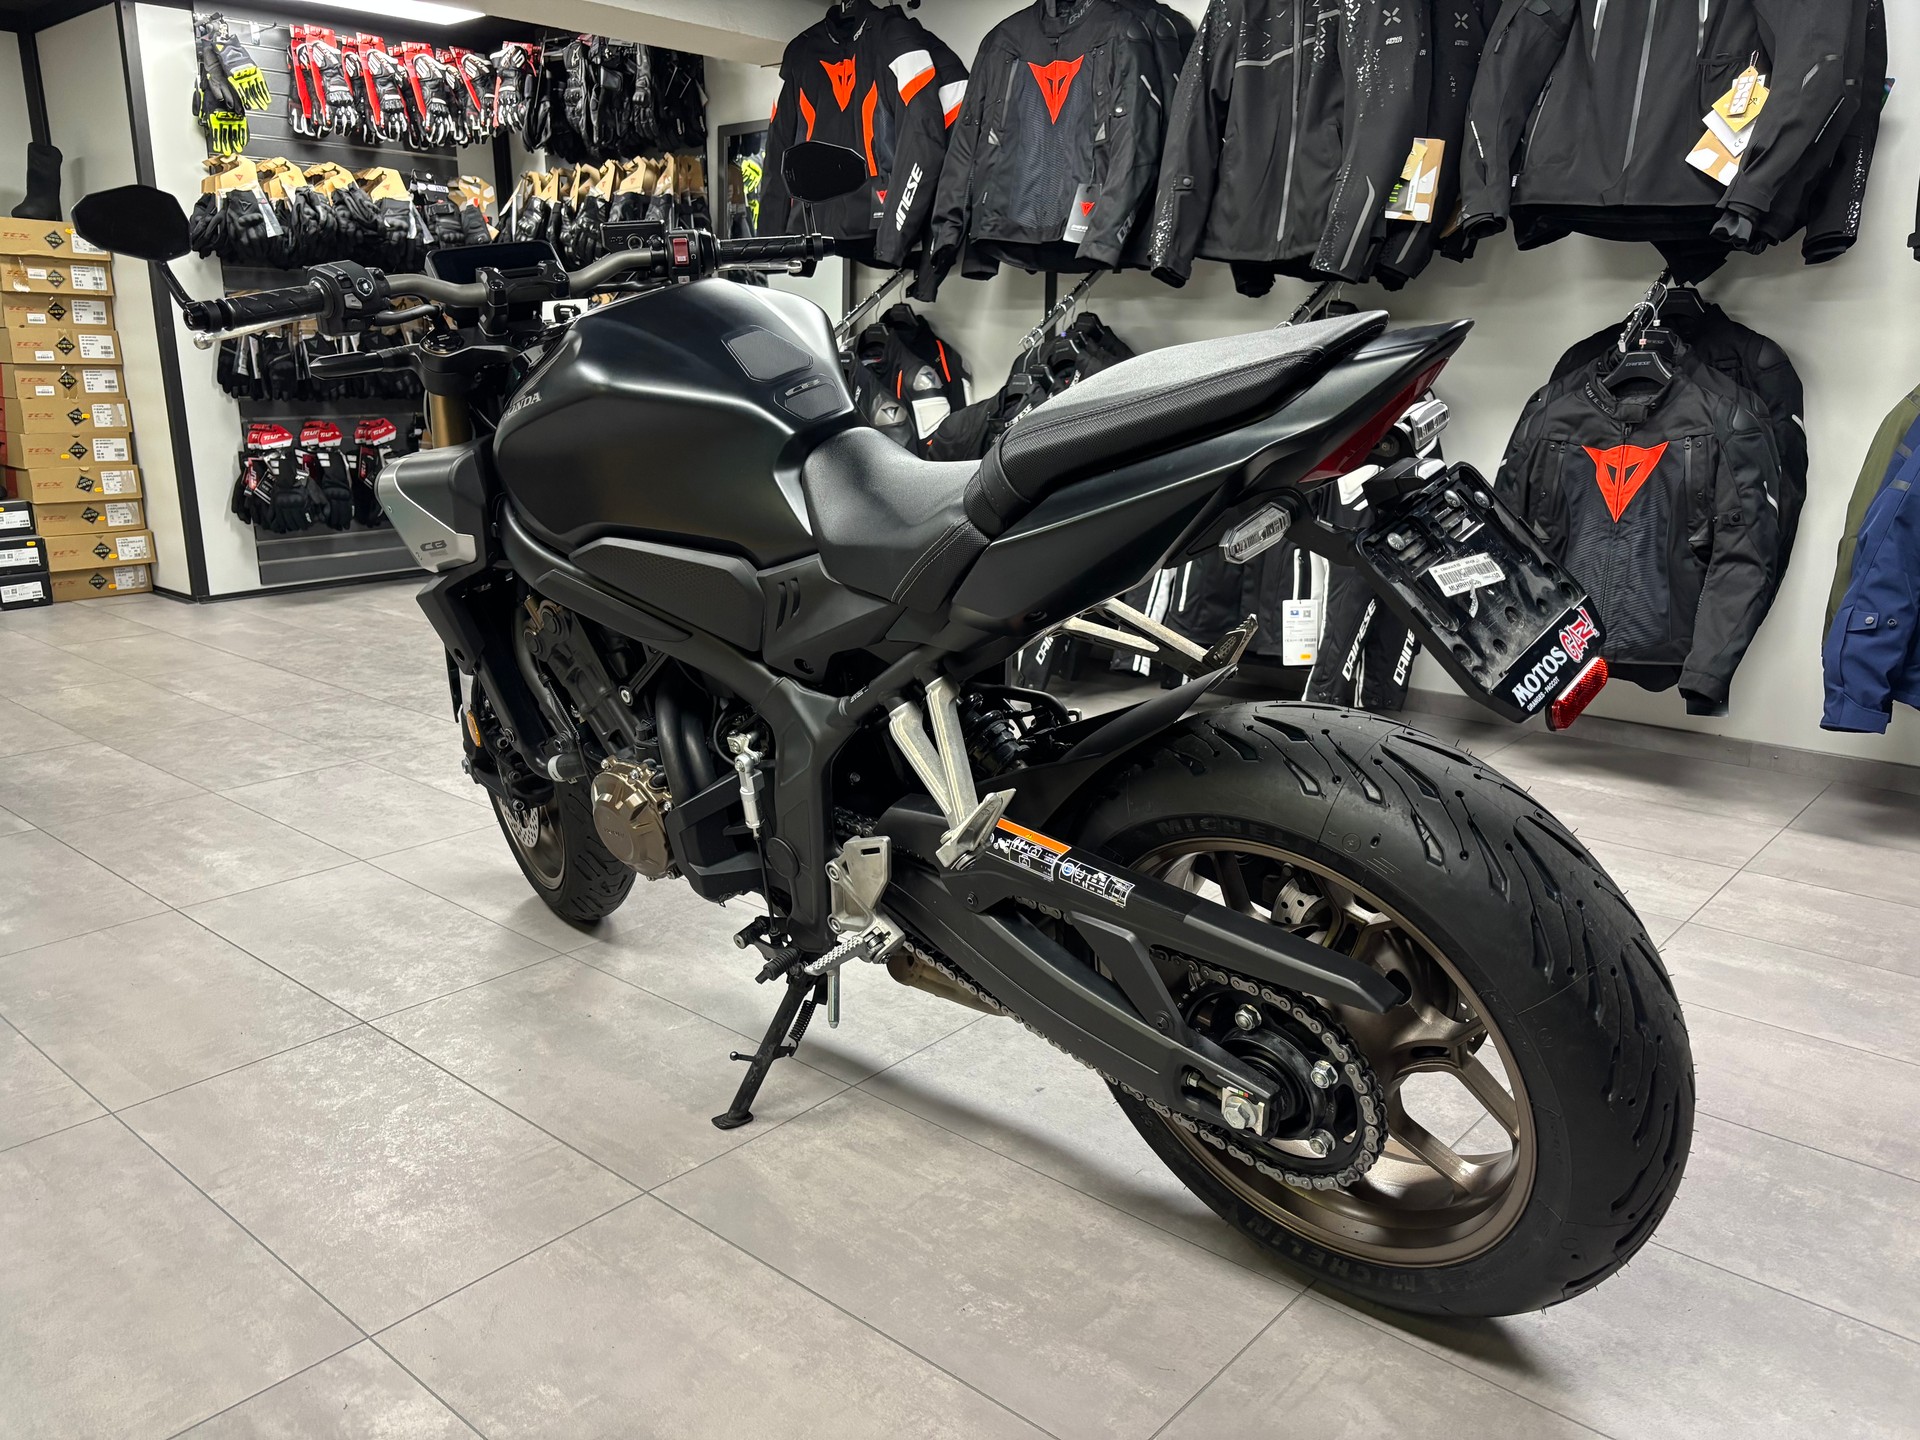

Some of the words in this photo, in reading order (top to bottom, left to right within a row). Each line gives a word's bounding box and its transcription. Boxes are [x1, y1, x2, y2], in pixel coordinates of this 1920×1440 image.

[420, 540, 447, 551] CB
[1341, 598, 1377, 682] DAINESE
[1511, 646, 1568, 708] MOTOS
[1526, 692, 1546, 712] GRANGES
[1546, 676, 1560, 693] PACCOT
